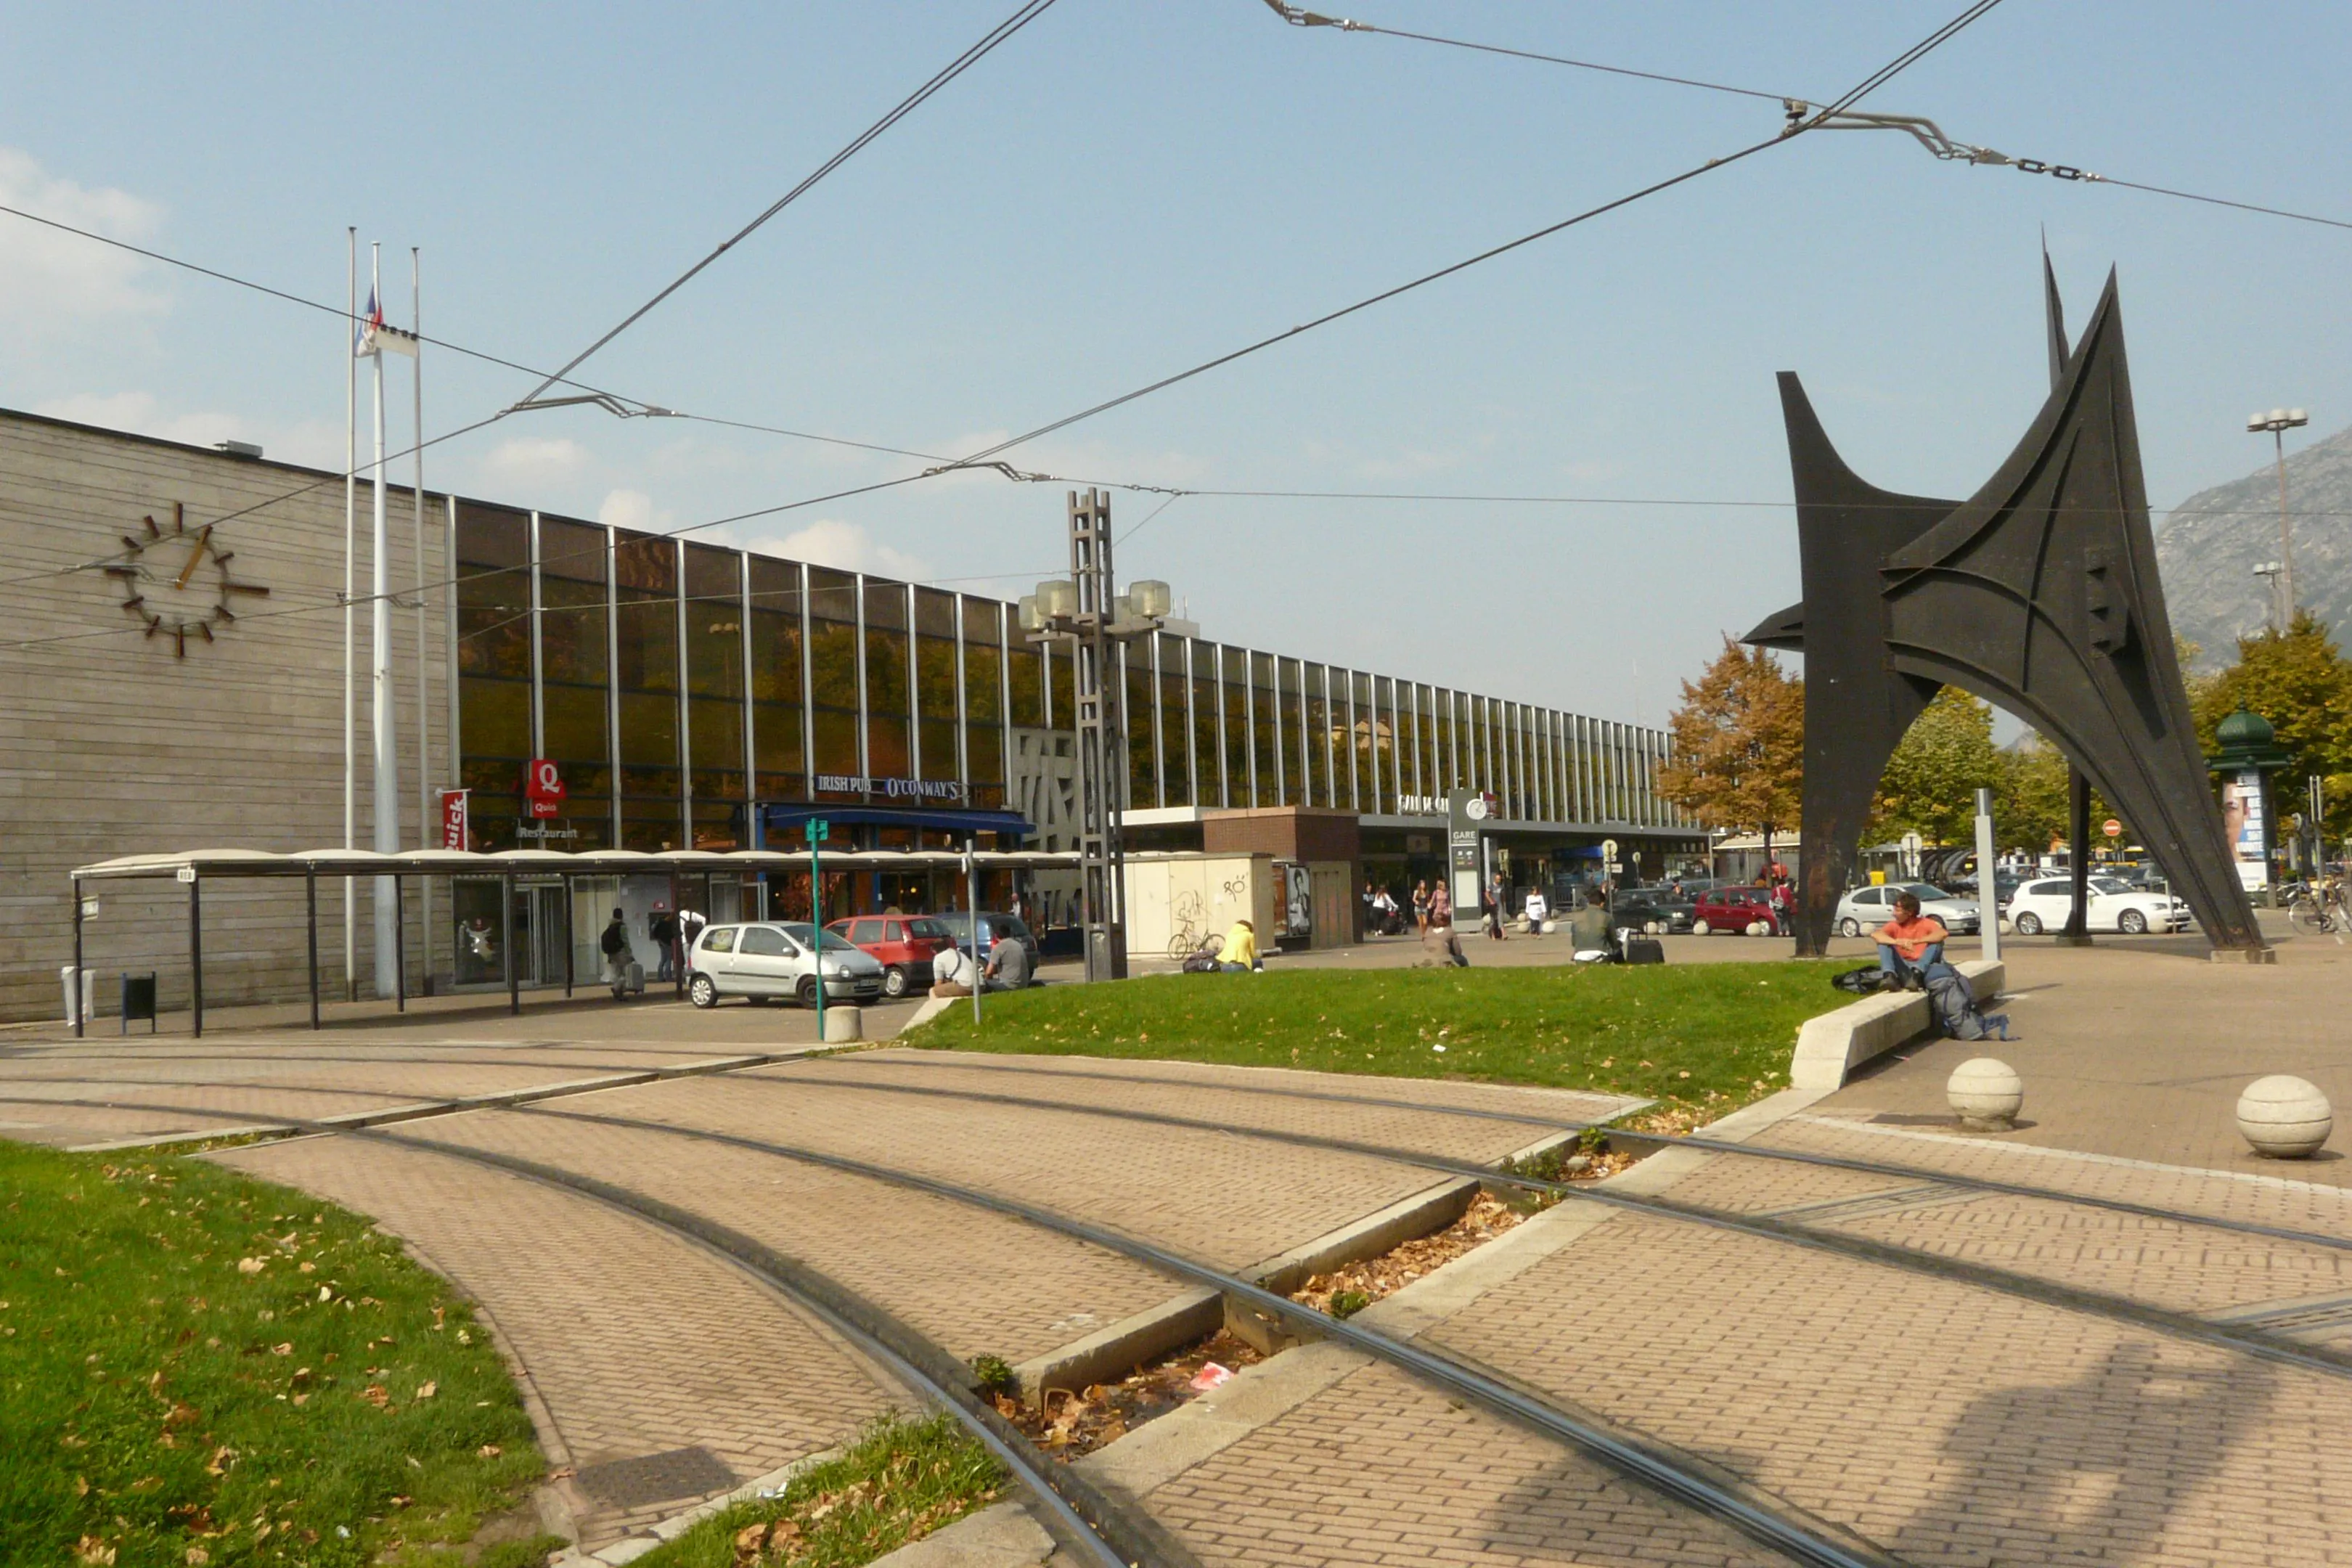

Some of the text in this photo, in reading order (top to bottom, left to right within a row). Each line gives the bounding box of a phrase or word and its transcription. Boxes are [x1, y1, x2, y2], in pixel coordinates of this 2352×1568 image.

[539, 764, 560, 793] Q
[818, 775, 871, 793] IRISH PUB
[887, 777, 957, 799] O'CONWAY'S
[519, 827, 578, 838] Restaurant
[1453, 830, 1476, 840] GARE
